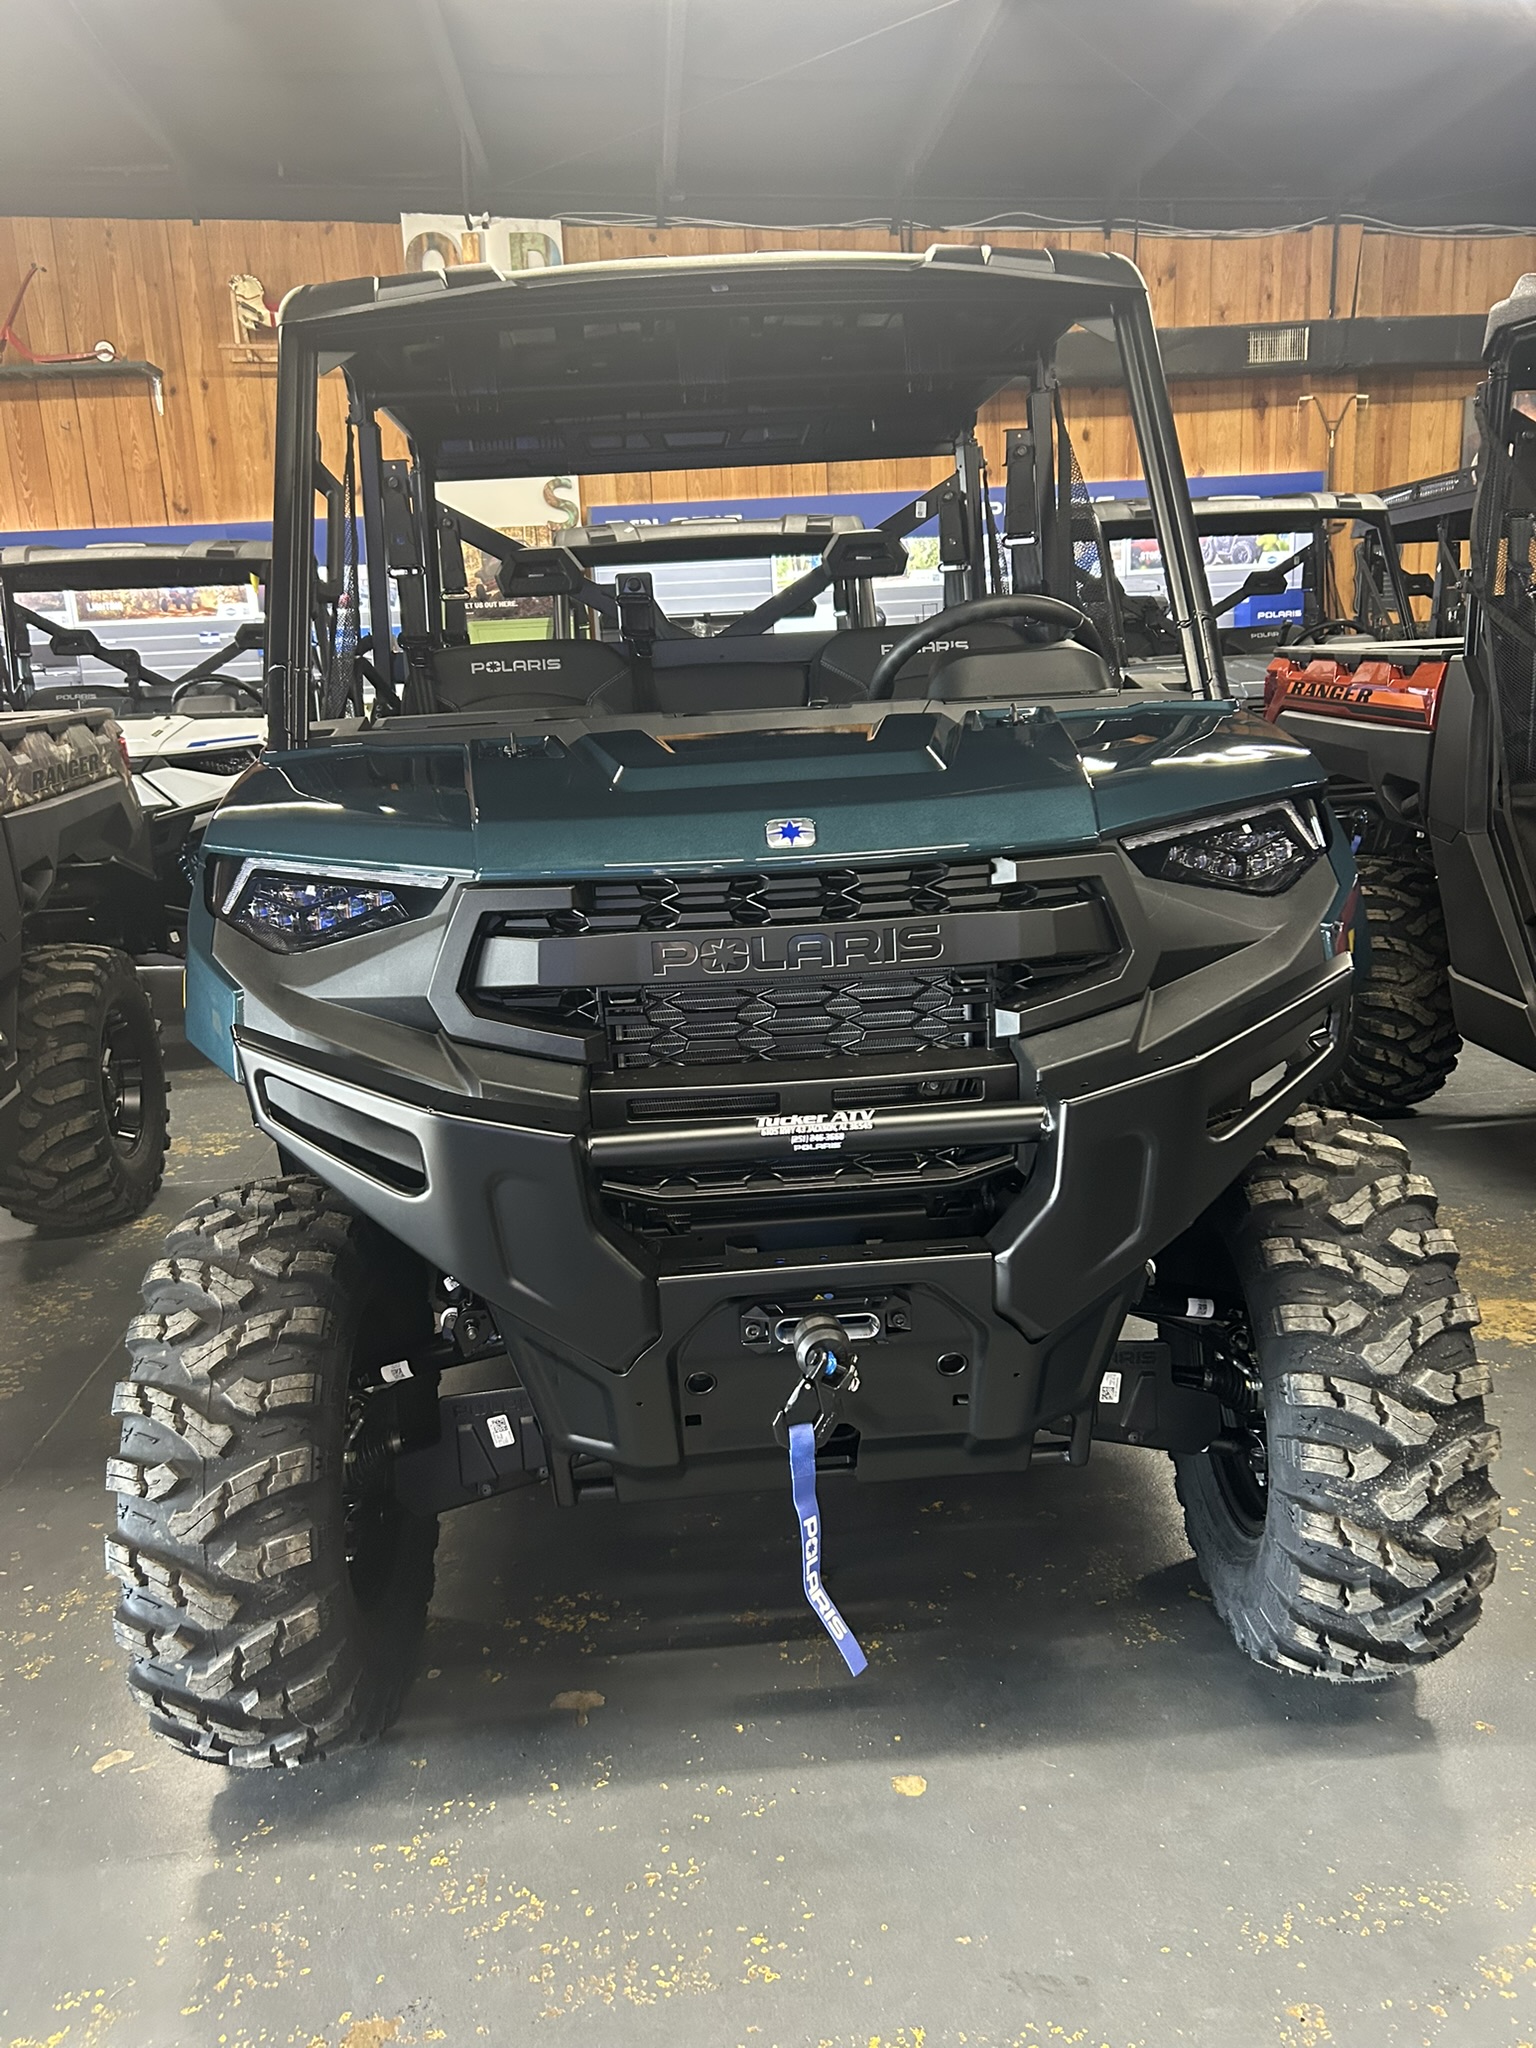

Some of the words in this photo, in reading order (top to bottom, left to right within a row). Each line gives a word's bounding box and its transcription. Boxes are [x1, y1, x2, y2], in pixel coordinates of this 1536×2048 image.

[1257, 609, 1302, 619] POLARIS
[470, 658, 562, 674] POLARIS
[55, 693, 97, 701] POLARIS
[1290, 681, 1373, 703] RANGER
[32, 754, 99, 793] RANGER
[650, 924, 945, 977] POLARIS
[756, 1113, 829, 1128] Tucker
[830, 1109, 875, 1123] ATV
[793, 1141, 842, 1151] POLARIS
[803, 1515, 848, 1641] POLARIS
